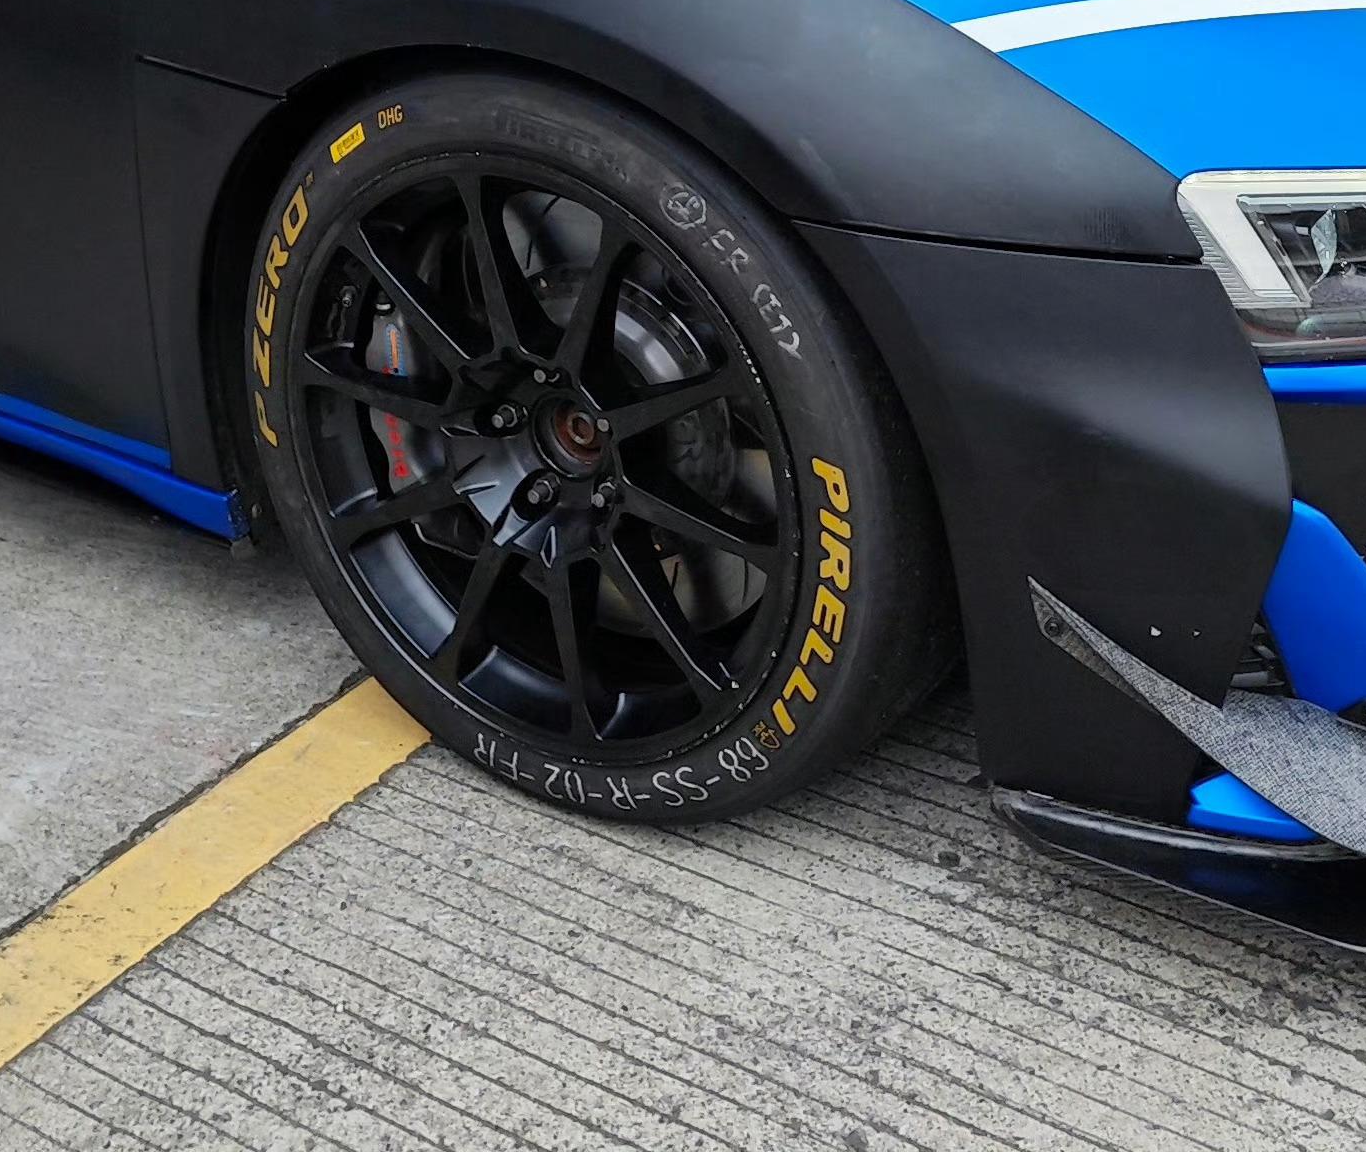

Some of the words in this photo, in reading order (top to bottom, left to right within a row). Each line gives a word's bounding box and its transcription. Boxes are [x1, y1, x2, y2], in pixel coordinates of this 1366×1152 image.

[252, 183, 309, 388] ZERO
[254, 390, 279, 448] P
[771, 457, 852, 736] PIRELLI
